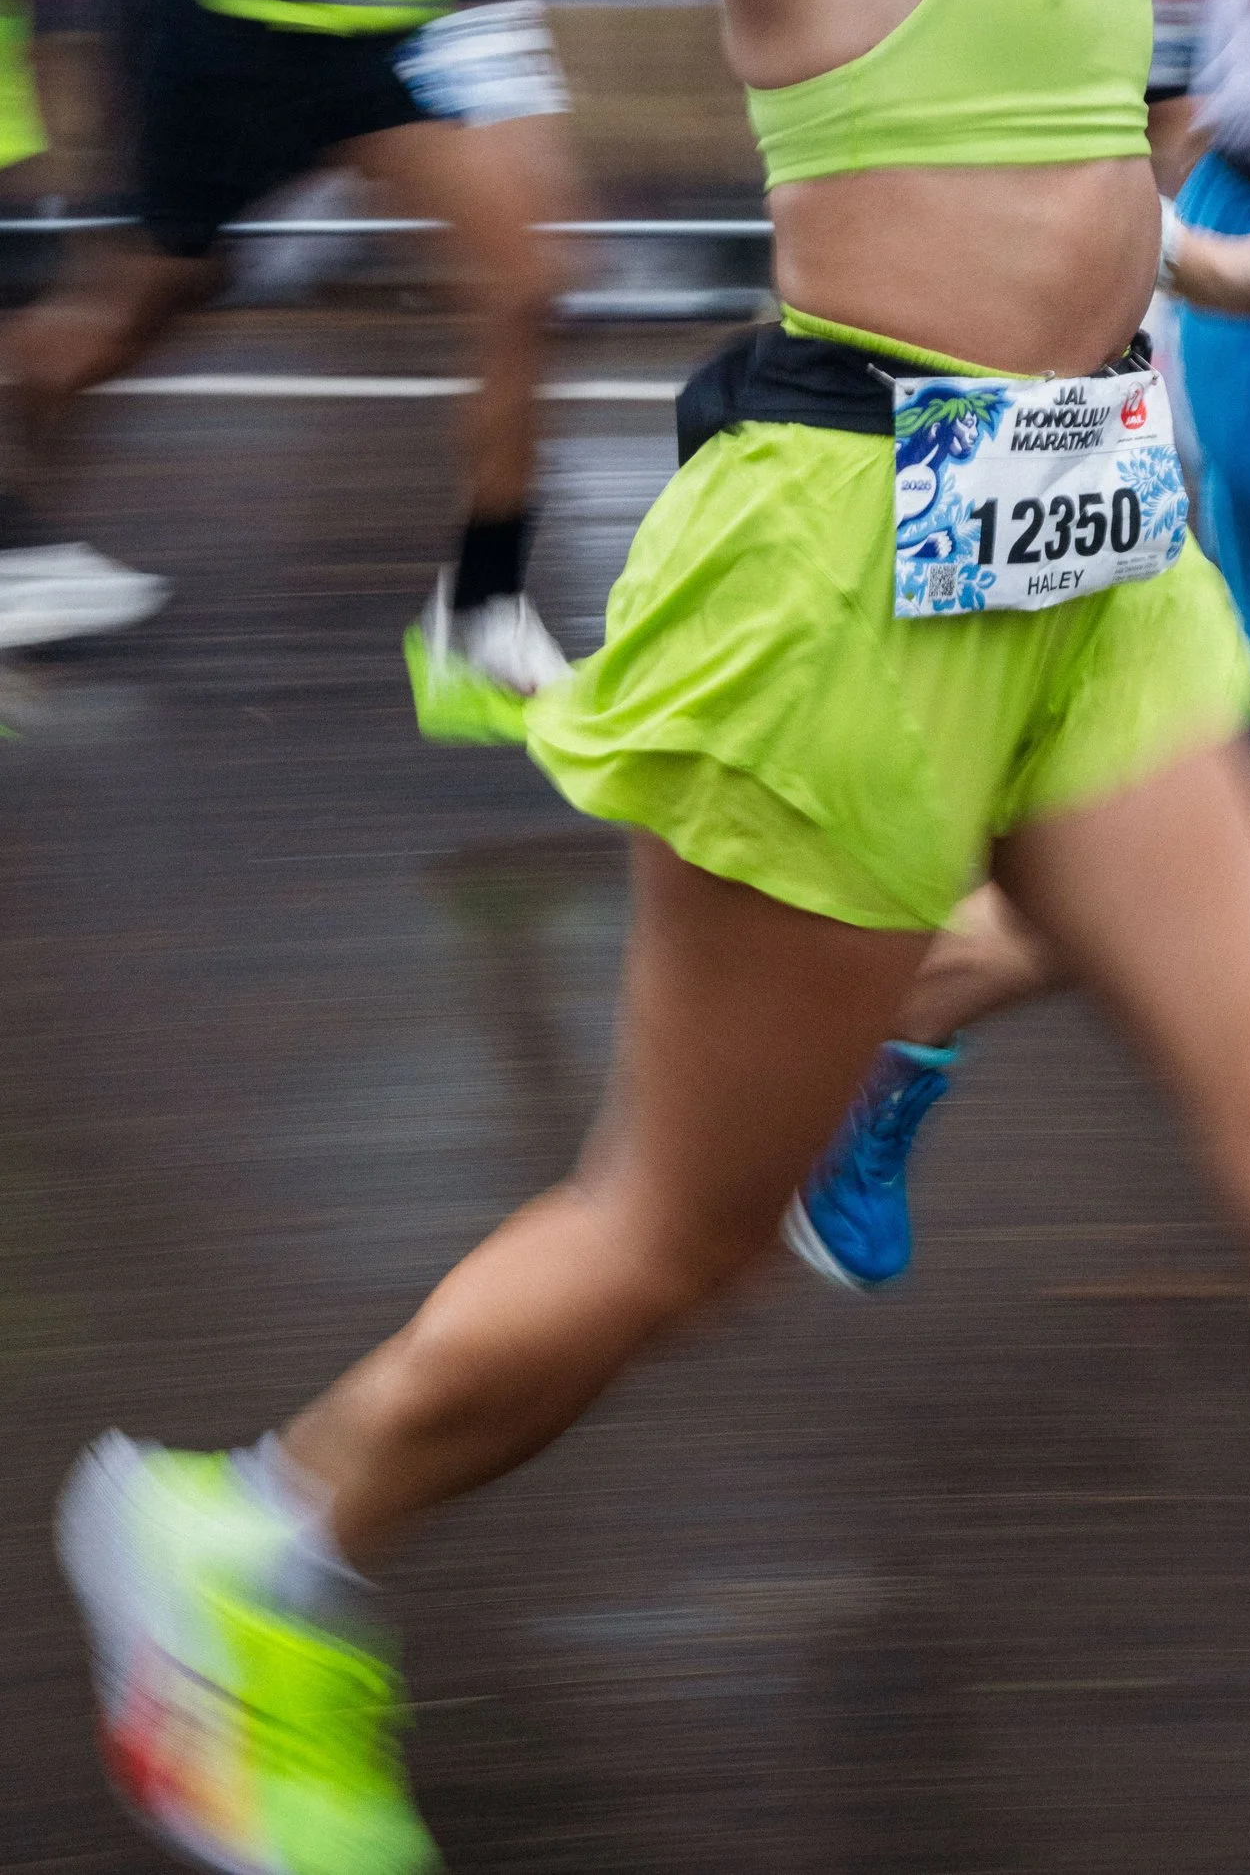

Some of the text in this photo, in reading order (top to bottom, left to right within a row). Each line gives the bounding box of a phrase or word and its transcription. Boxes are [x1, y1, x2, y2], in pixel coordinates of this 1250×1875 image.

[1053, 386, 1087, 405] JAL
[1015, 406, 1110, 428] HONOLULU
[970, 487, 1141, 565] 12350
[1027, 569, 1085, 596] HALEY
